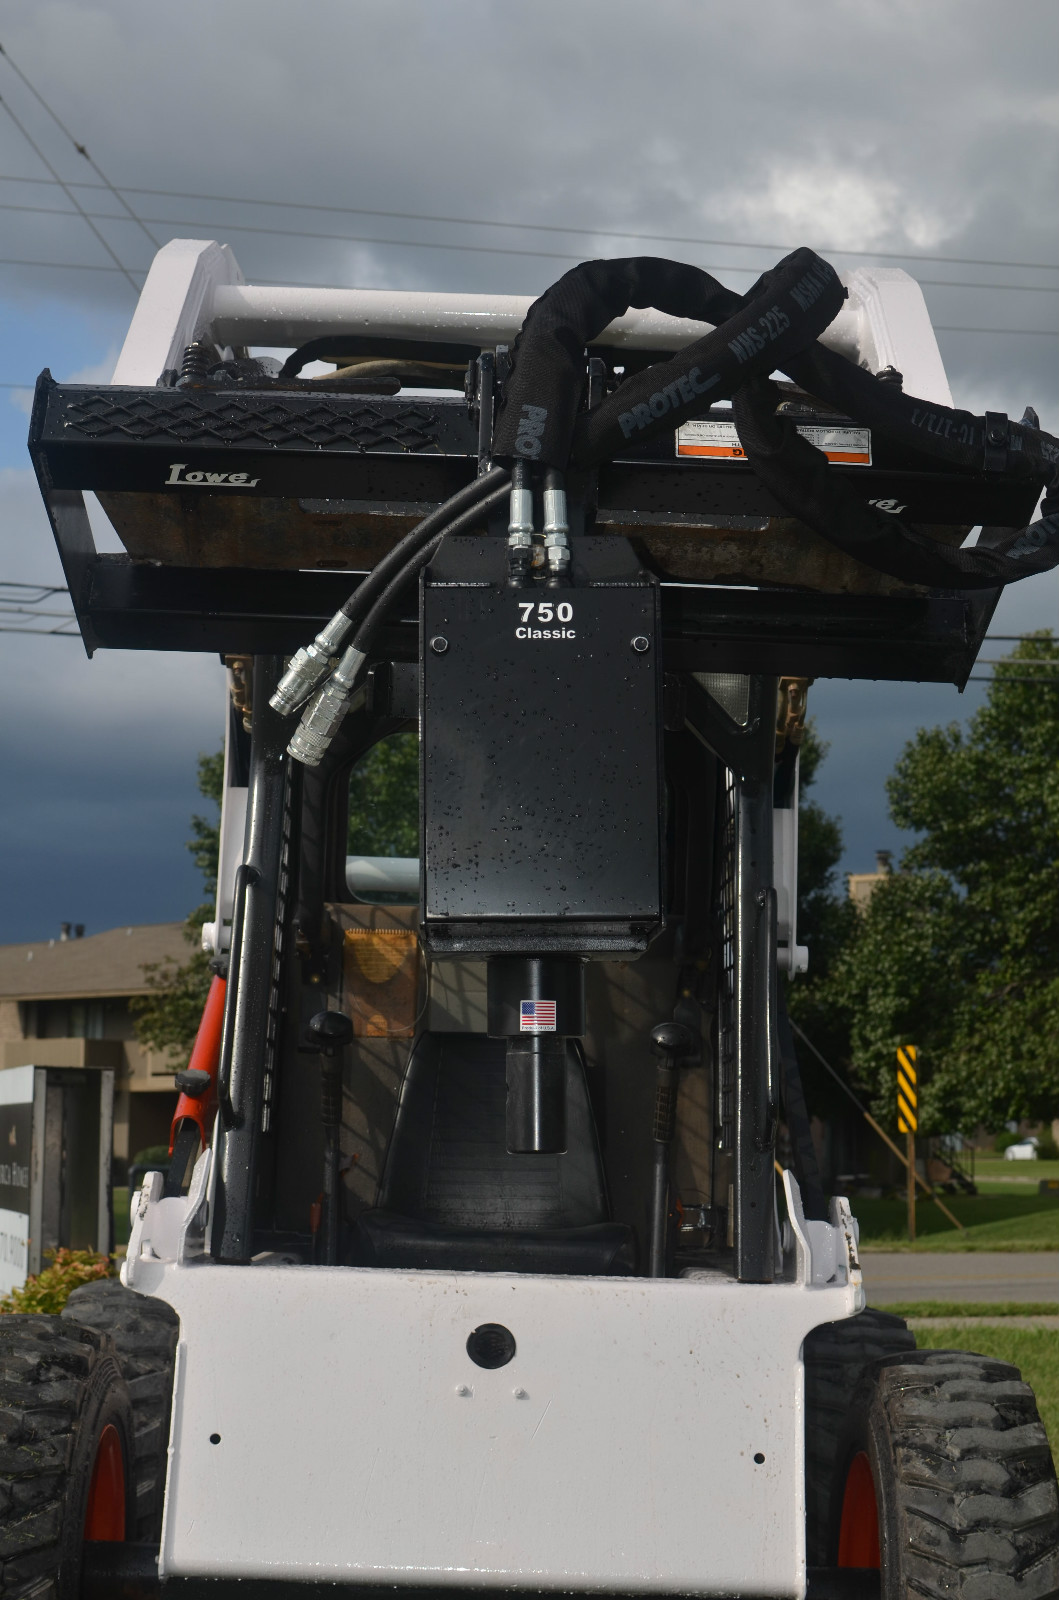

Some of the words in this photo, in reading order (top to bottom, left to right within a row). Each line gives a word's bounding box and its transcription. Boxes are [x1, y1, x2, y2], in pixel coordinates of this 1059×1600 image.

[618, 367, 721, 439] PROTEC
[728, 305, 791, 364] NHS-225
[165, 463, 261, 488] Lowe
[518, 602, 574, 623] 750
[515, 627, 576, 639] Classic
